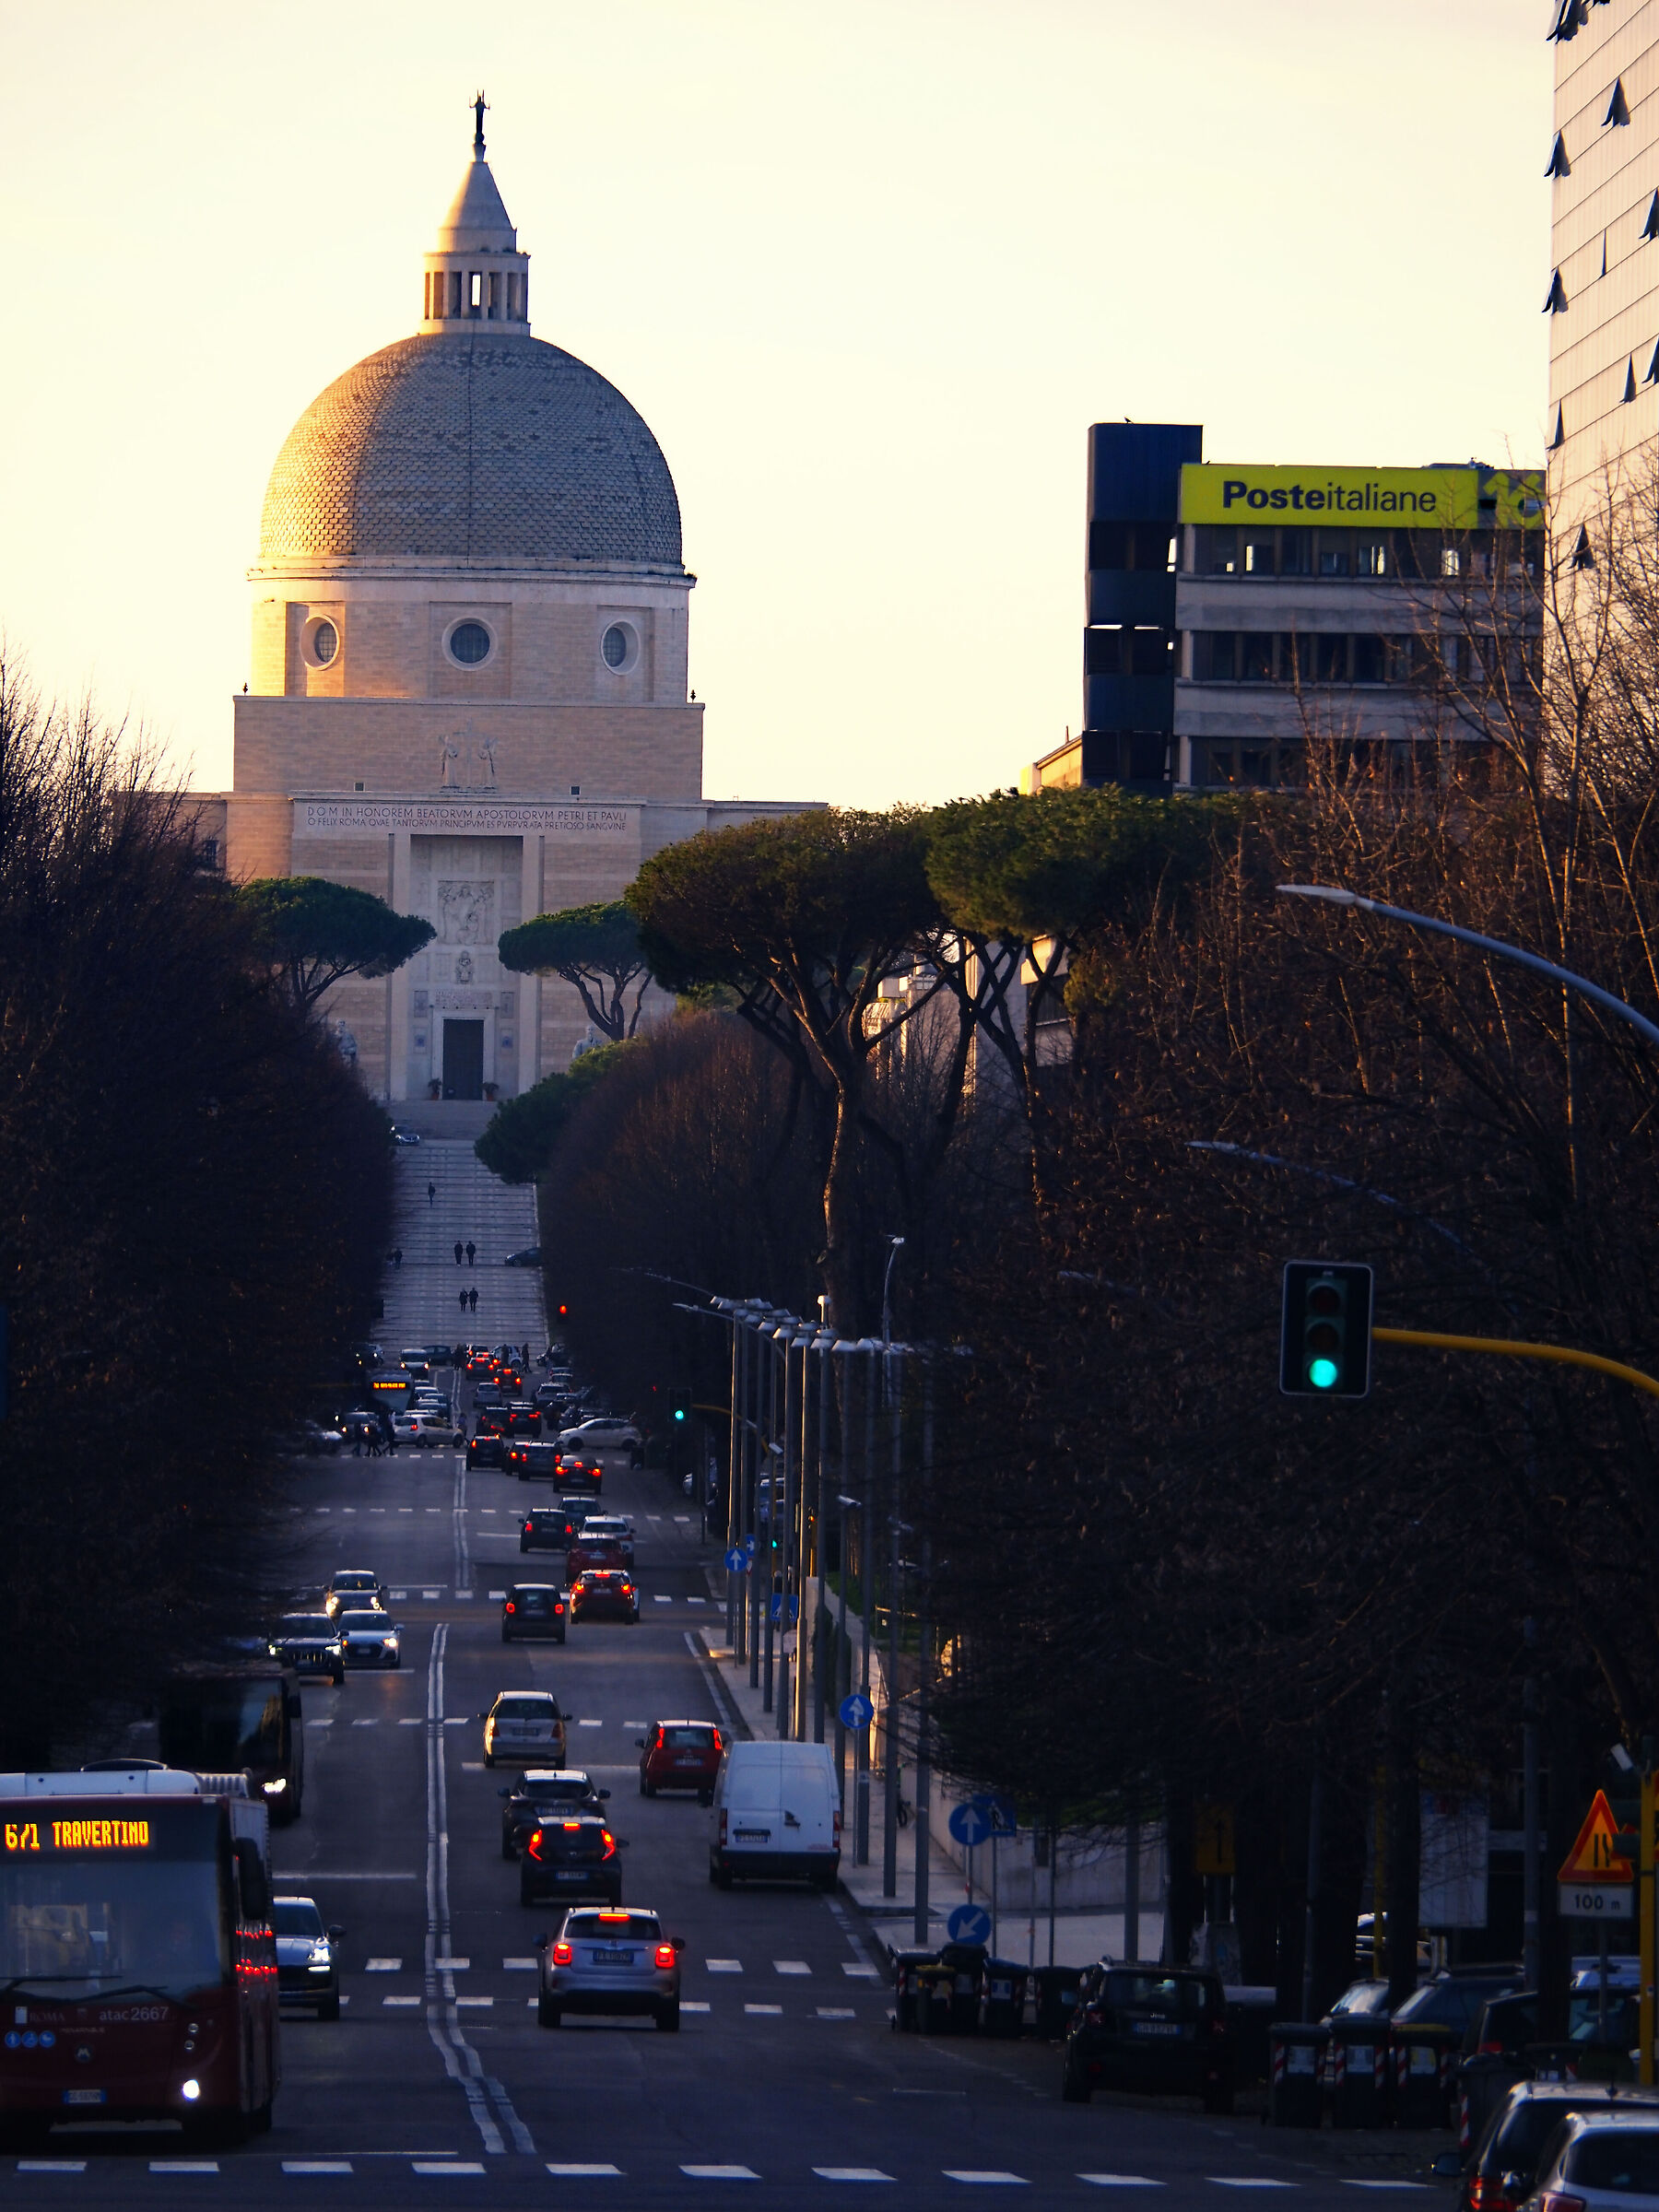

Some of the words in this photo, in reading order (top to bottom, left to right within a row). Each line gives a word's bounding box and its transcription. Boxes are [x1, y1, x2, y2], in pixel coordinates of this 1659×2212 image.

[342, 807, 352, 818] IN
[357, 807, 413, 818] HONOREM
[418, 808, 473, 819] BEATORVM
[476, 809, 554, 820] APOSTOLORVM
[558, 810, 584, 821] PETRI
[587, 811, 598, 821] ET
[601, 811, 627, 822] PAVLI
[308, 818, 316, 827] O
[317, 818, 338, 827] FELIX
[340, 818, 365, 828] ROMA
[393, 819, 438, 829] TANTORVM
[440, 819, 485, 830] PRINCIPVM
[487, 820, 495, 830] ES
[497, 820, 543, 830] PVRPVRATA
[545, 821, 584, 831] PRETIOSO
[586, 822, 627, 831] SANGVINE
[52, 1820, 149, 1848] TRAVERTINO
[1575, 1894, 1604, 1910] 100
[1610, 1900, 1621, 1910] m
